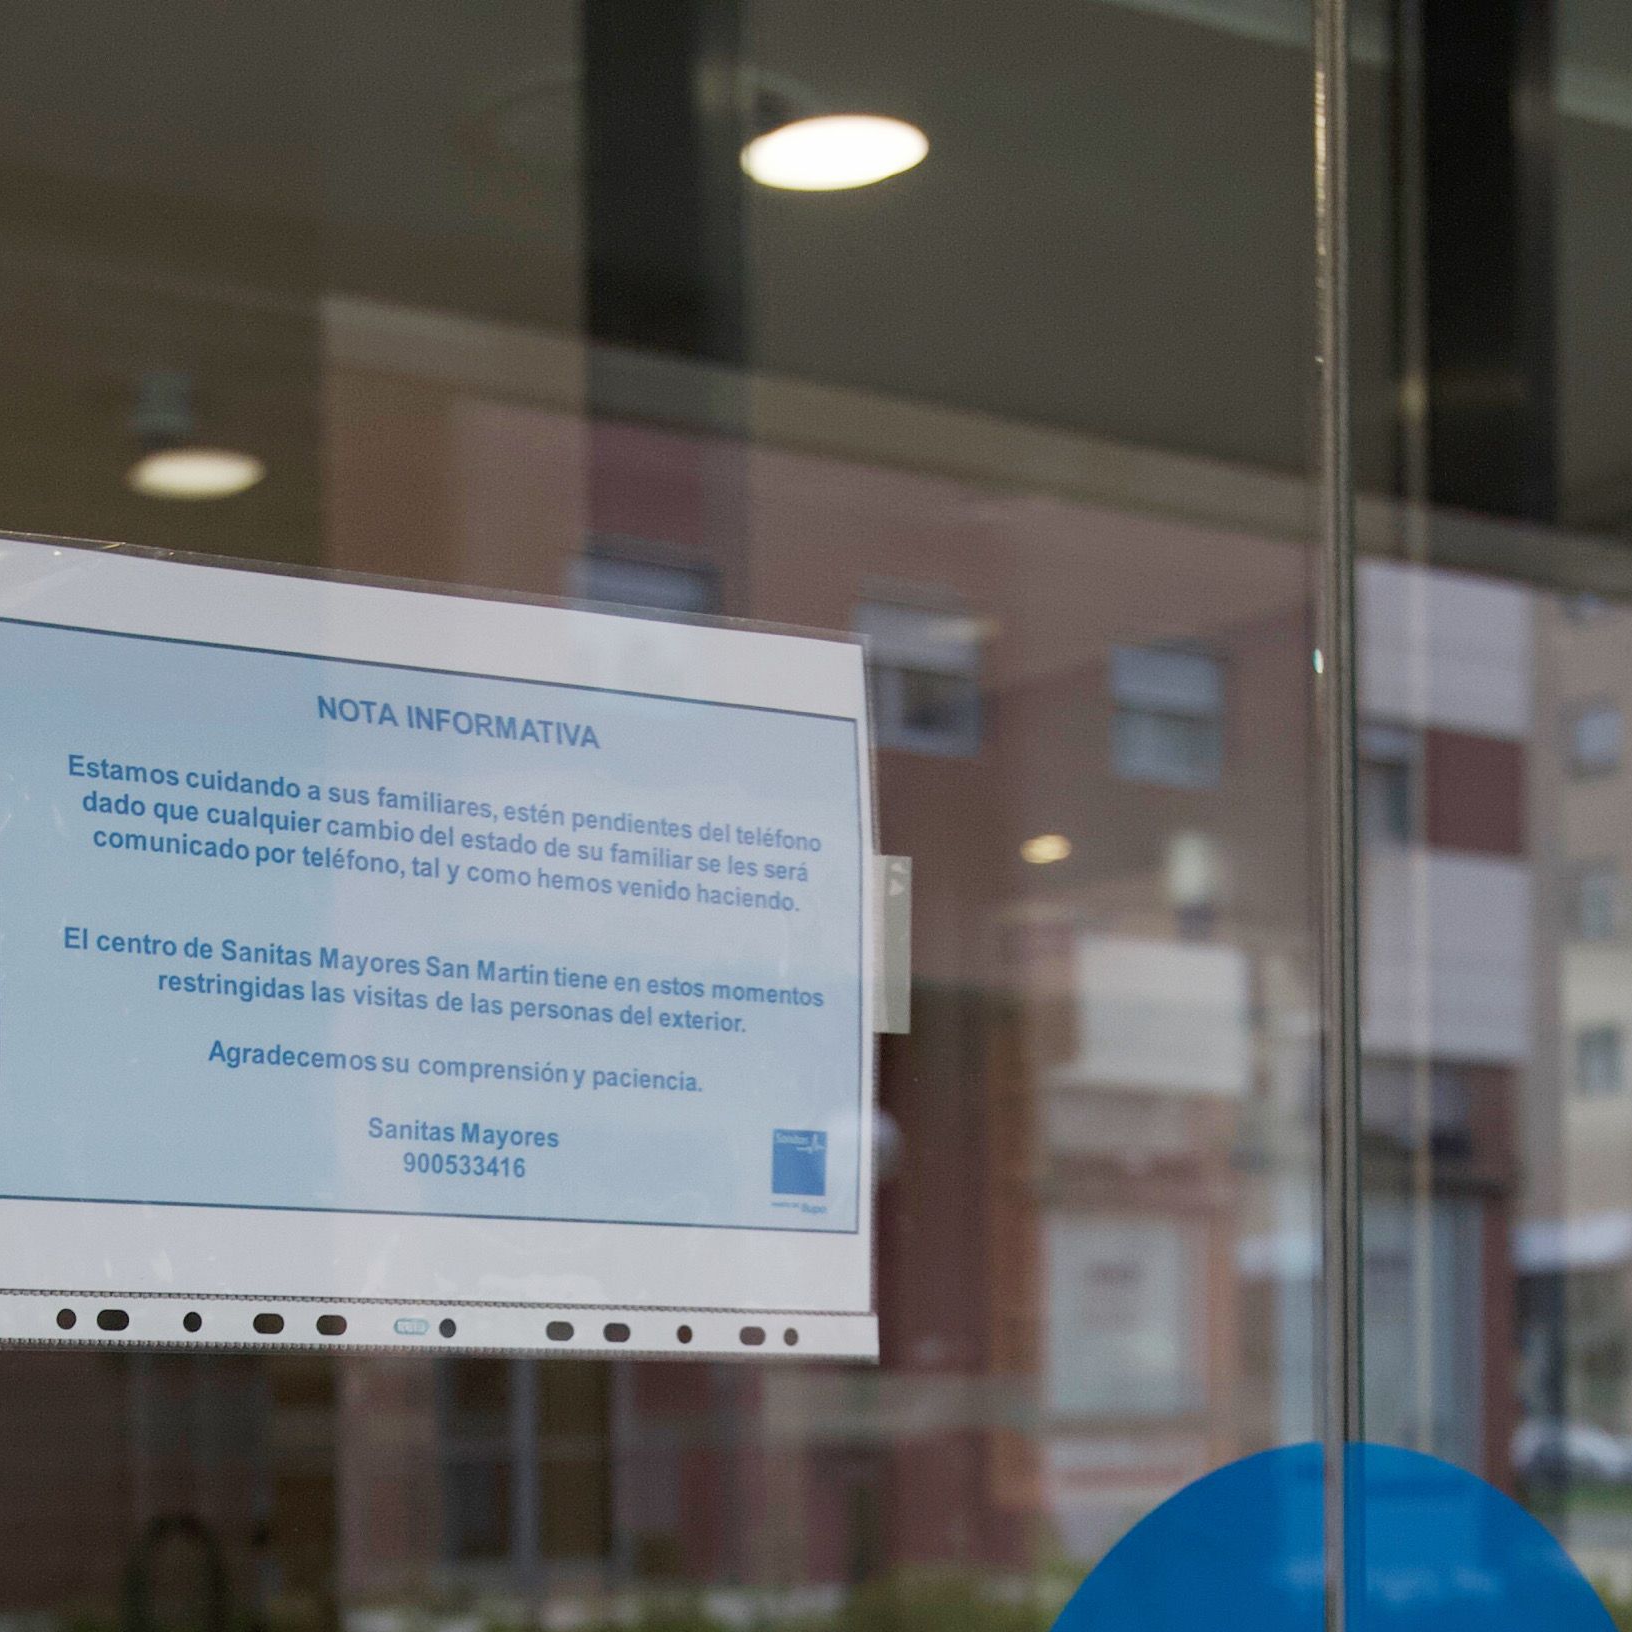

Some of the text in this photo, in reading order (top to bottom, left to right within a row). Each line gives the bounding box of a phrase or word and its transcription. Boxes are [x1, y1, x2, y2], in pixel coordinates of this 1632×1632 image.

[316, 694, 601, 750] NOTA INFORMATIVA
[68, 753, 823, 853] Estamos cuidando a sus familiares, estén pendientes del teléfono
[81, 789, 809, 883] dado que cualquier cambio del estado de su familiar se les será
[92, 829, 801, 912] comunicado por teléfono, tal y como hemos venido haciendo.
[63, 926, 89, 951] El
[95, 933, 178, 958] centro
[182, 936, 214, 960] de
[220, 938, 313, 968] Sanitas
[319, 946, 421, 978] Mayores
[425, 954, 470, 980] San
[552, 966, 609, 991] tiene
[612, 975, 642, 994] en
[646, 976, 706, 999] estos
[710, 983, 825, 1008] momentos
[157, 972, 747, 1033] restringidas las visitas de las personas del exterior.
[208, 1039, 704, 1093] Agradecemos su comprensión y paciencia.
[367, 1116, 560, 1151] Sanitas Mayores
[402, 1151, 527, 1179] 900533416
